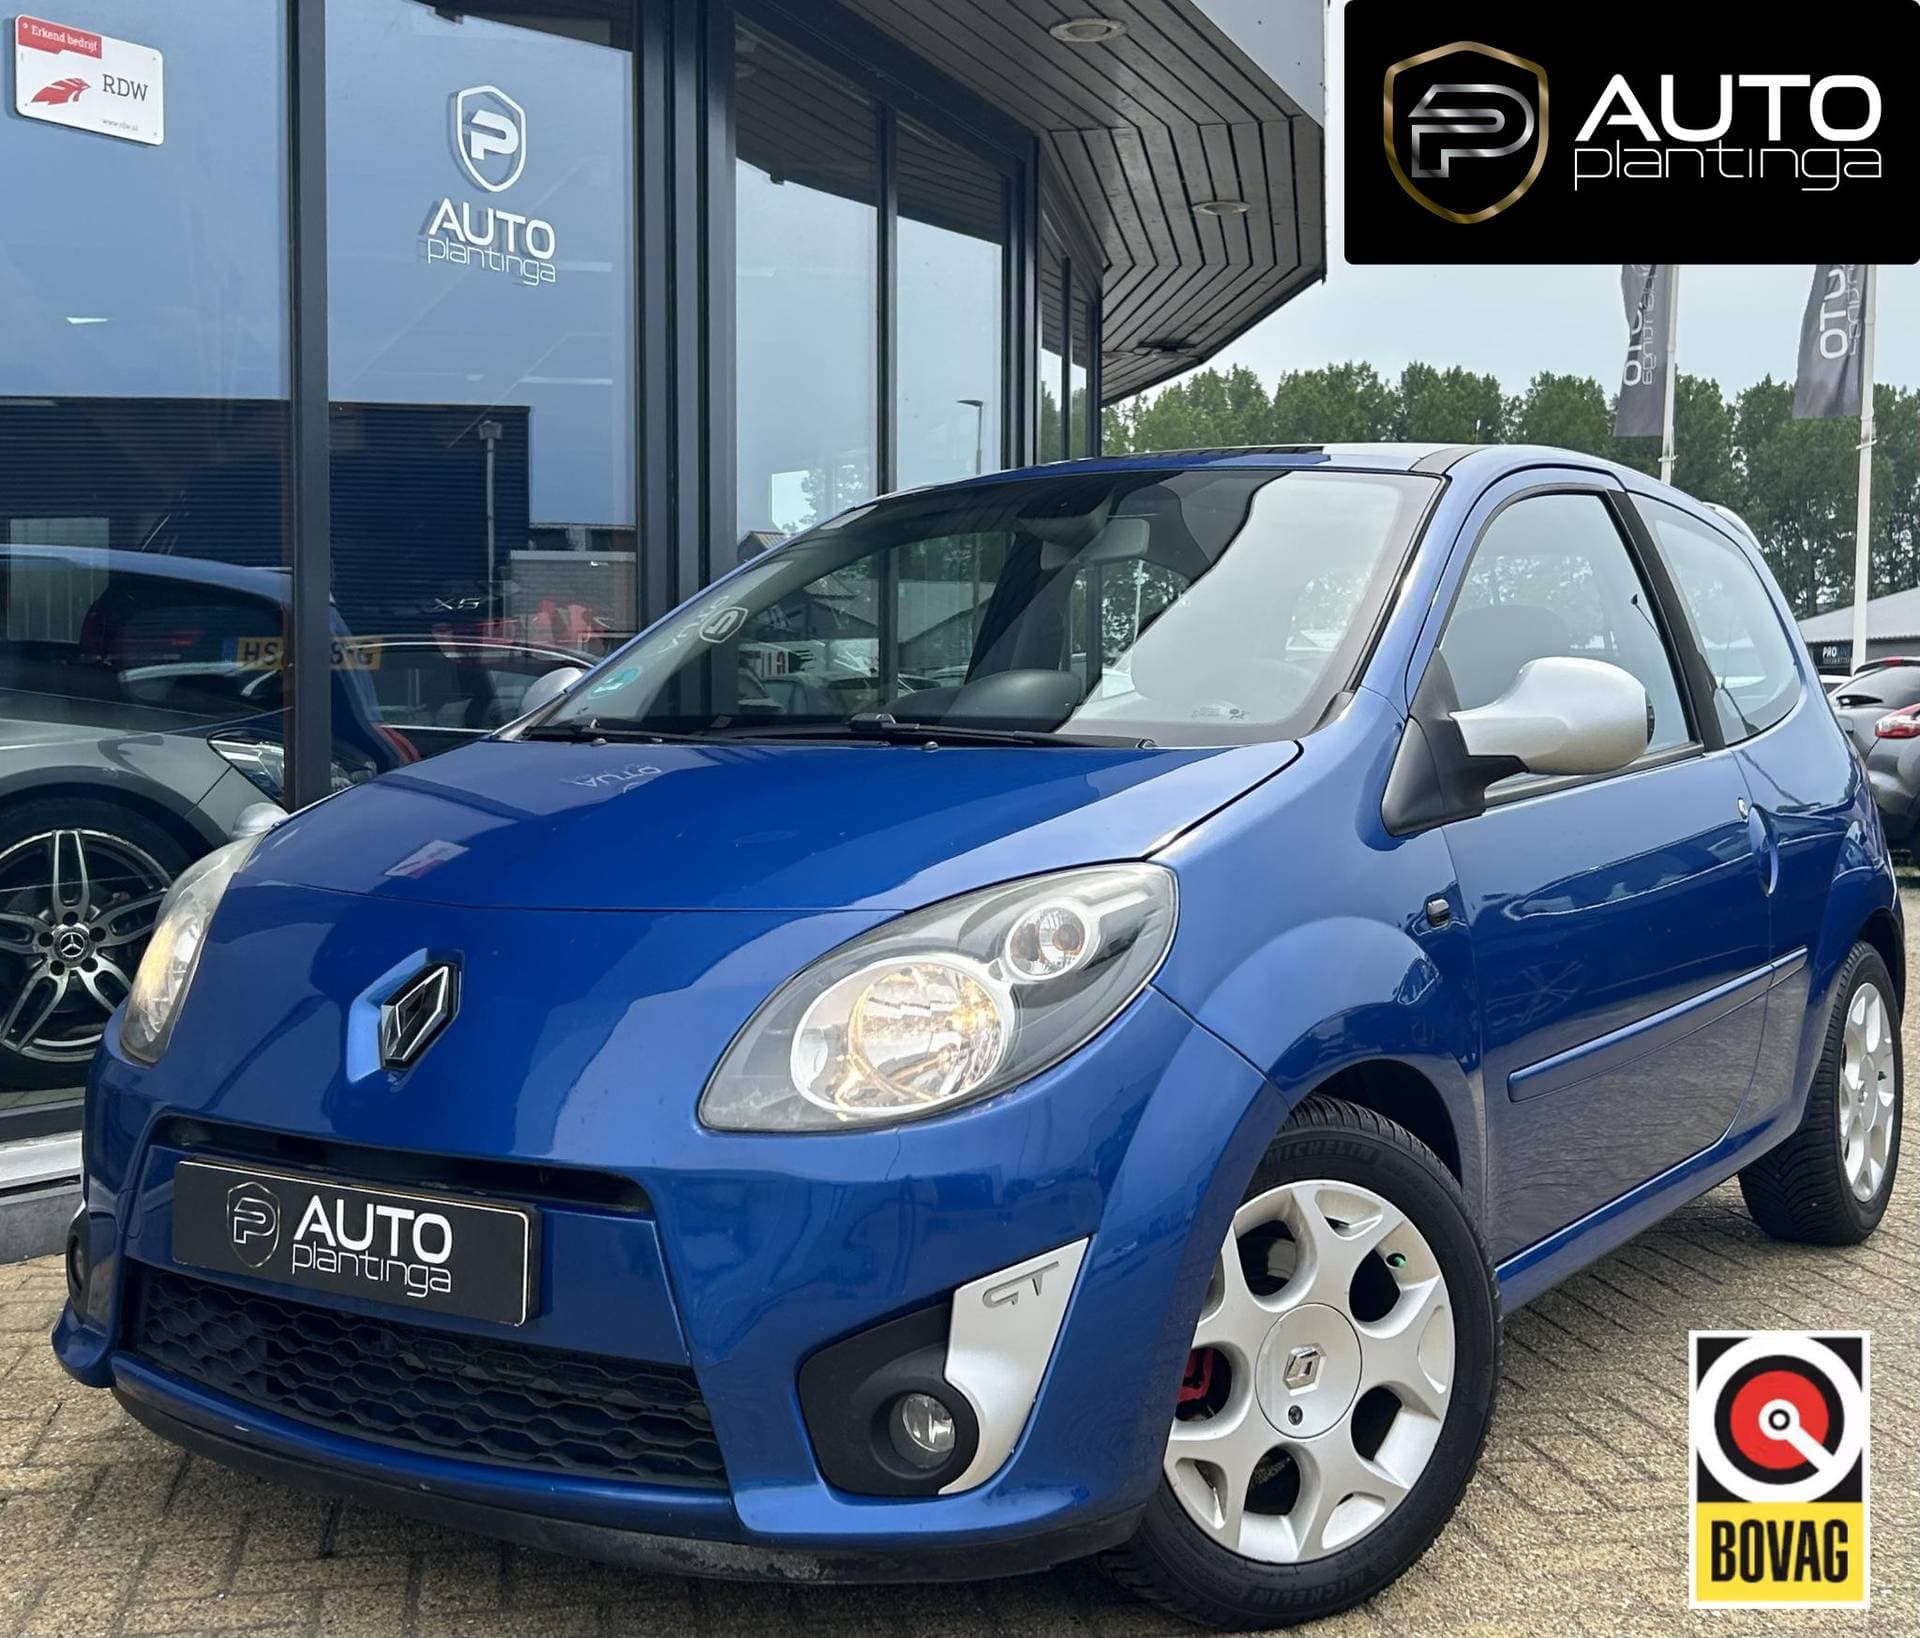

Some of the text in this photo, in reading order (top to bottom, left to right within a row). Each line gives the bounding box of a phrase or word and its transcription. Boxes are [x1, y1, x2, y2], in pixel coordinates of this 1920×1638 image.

[31, 25, 98, 53] Erkend bedrijf
[102, 74, 149, 101] RDW
[428, 198, 556, 260] AUTO
[427, 238, 556, 286] plantinga
[293, 1194, 454, 1265] AUTO
[292, 1240, 452, 1298] plantinga
[982, 1260, 1060, 1309] GT
